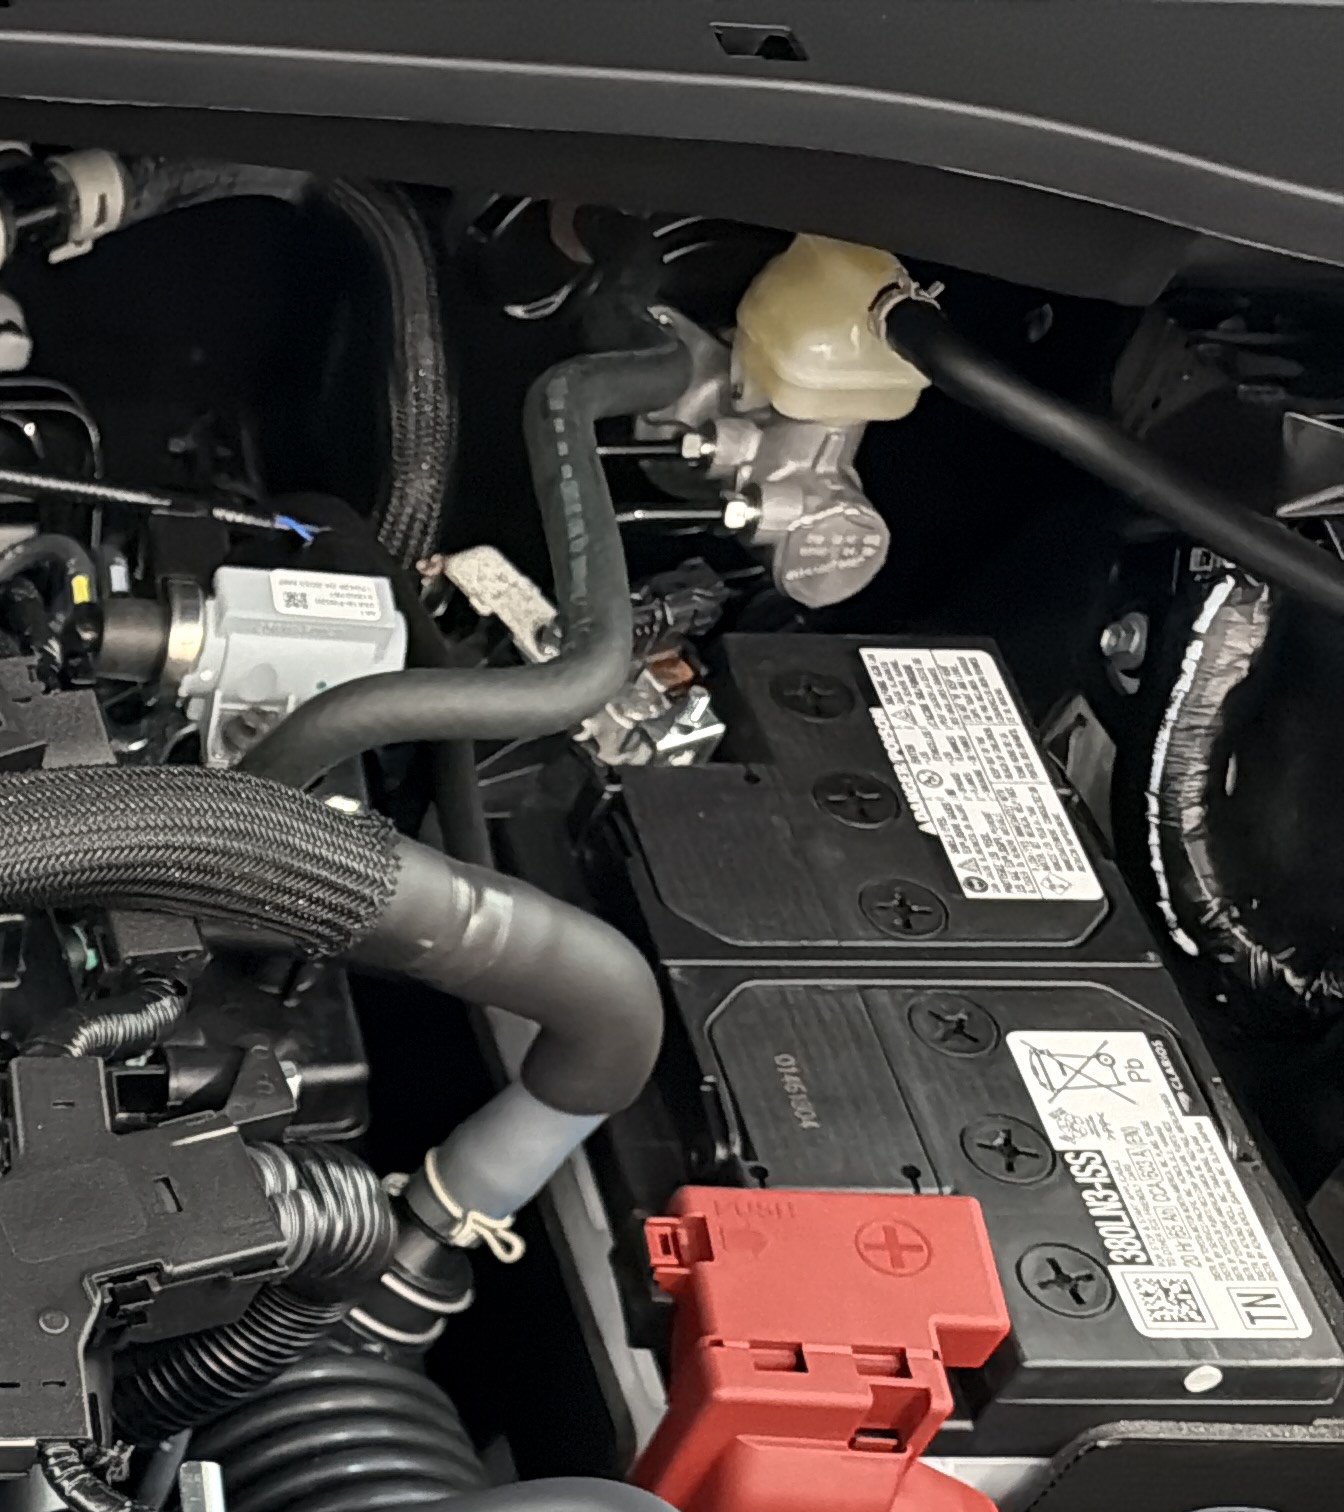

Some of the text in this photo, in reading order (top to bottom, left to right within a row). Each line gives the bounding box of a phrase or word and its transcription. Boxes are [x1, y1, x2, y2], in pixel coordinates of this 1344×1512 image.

[1125, 1058, 1151, 1082] Pb
[1064, 1152, 1147, 1263] 380LN3-ISS
[1236, 1293, 1287, 1324] TN
